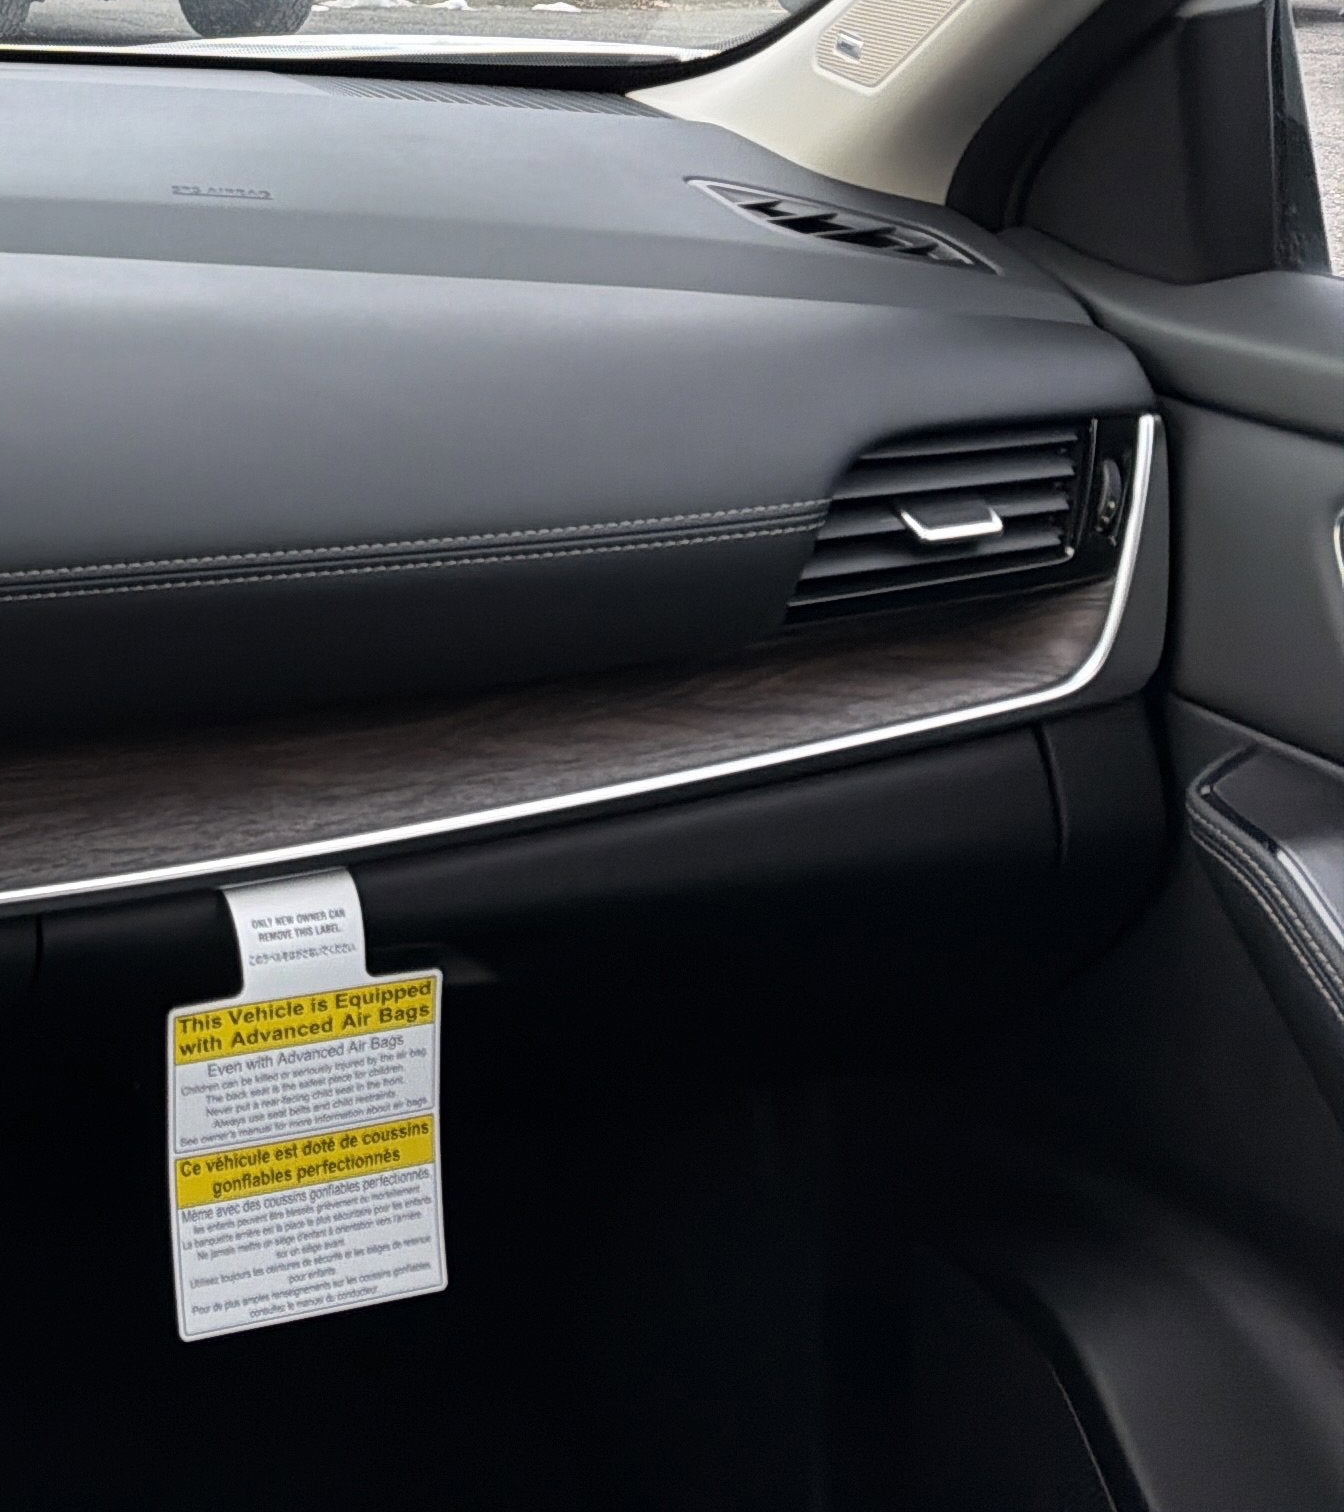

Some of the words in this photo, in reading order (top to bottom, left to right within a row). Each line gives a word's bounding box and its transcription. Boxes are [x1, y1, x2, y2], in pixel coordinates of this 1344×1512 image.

[296, 911, 327, 923] OWNER
[257, 929, 294, 943] REMOVE
[294, 926, 314, 938] THIS
[181, 1016, 222, 1034] This
[230, 1002, 303, 1024] Vehicle
[311, 998, 328, 1012] is
[335, 981, 431, 1008] Equipped
[180, 1036, 222, 1056] with
[232, 1017, 332, 1046] Advanced
[342, 1012, 371, 1030] Air
[379, 1004, 429, 1024] Bags
[207, 1062, 241, 1077] Even
[246, 1056, 272, 1070] with
[277, 1044, 343, 1064] Advanced
[348, 1040, 365, 1054] Air
[371, 1034, 403, 1050] Bags
[222, 1080, 238, 1089] can
[242, 1076, 252, 1086] be
[380, 1054, 392, 1062] the
[206, 1094, 223, 1104] The
[226, 1090, 246, 1101] back
[250, 1086, 268, 1097] seat
[282, 1082, 295, 1092] the
[206, 1106, 232, 1117] Never
[236, 1102, 250, 1113] put
[312, 1088, 329, 1099] child
[366, 1080, 380, 1090] the
[214, 1118, 242, 1128] Always
[180, 1138, 197, 1146] See
[181, 1160, 200, 1177] Ce
[206, 1150, 269, 1172] véhicule
[275, 1144, 297, 1161] est
[302, 1137, 333, 1156] doté
[340, 1134, 357, 1150] de
[362, 1122, 428, 1144] coussins
[296, 1150, 399, 1181] perfectionnés
[216, 1204, 239, 1218] avec
[243, 1200, 261, 1212] des
[264, 1192, 306, 1208] coussins
